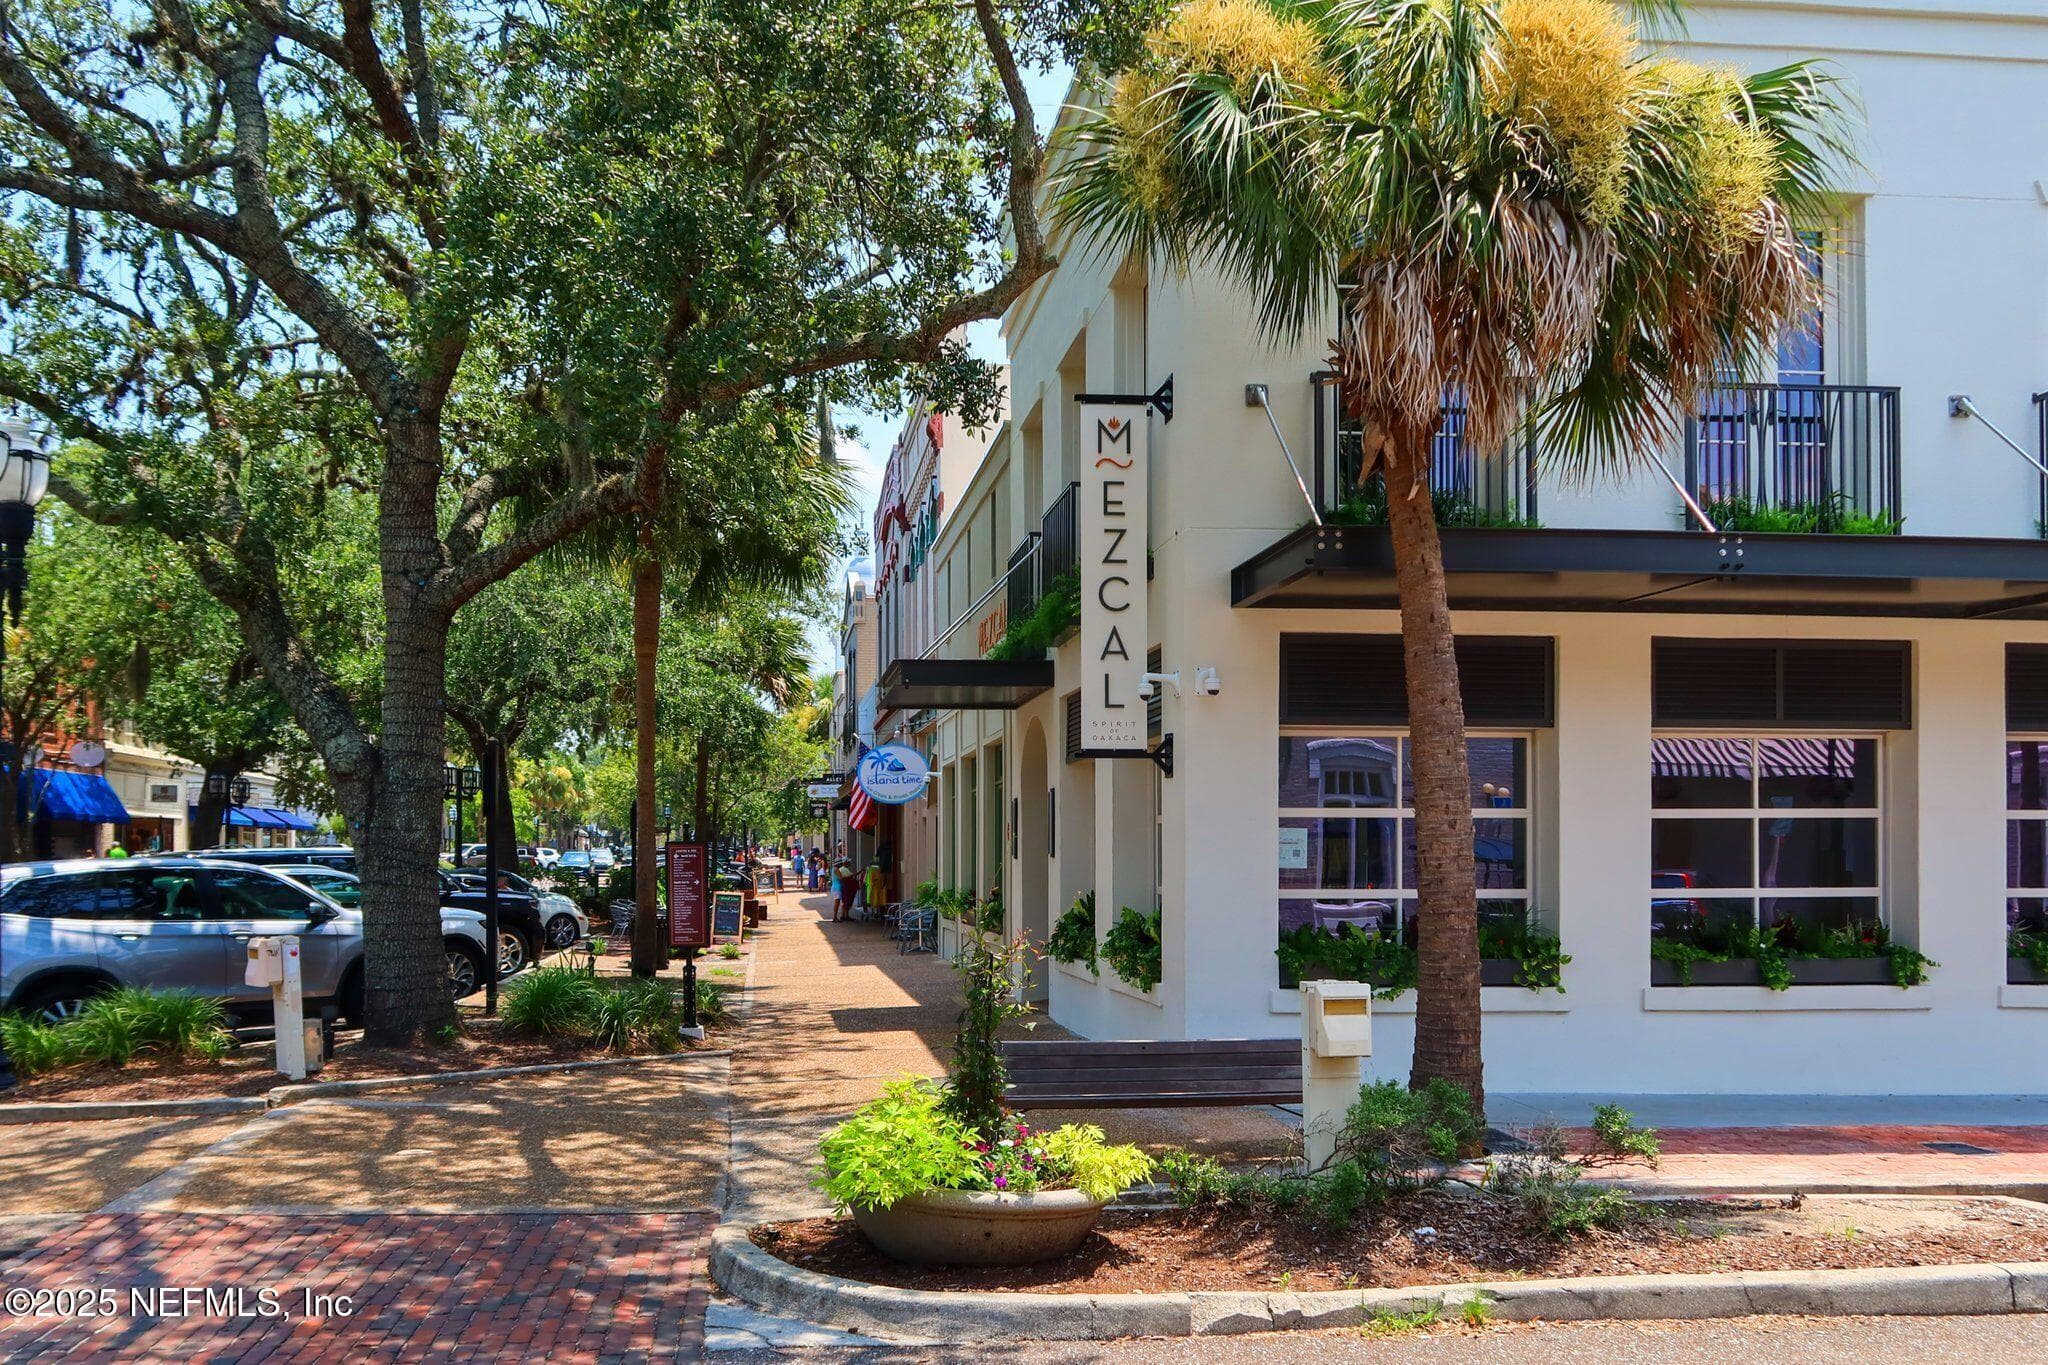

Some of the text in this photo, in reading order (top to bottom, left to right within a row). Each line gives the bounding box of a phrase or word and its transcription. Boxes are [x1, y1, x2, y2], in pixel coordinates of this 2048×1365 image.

[1097, 417, 1131, 709] MEZCAL
[1092, 720, 1136, 728] SPIRIT
[867, 775, 923, 785] island time
